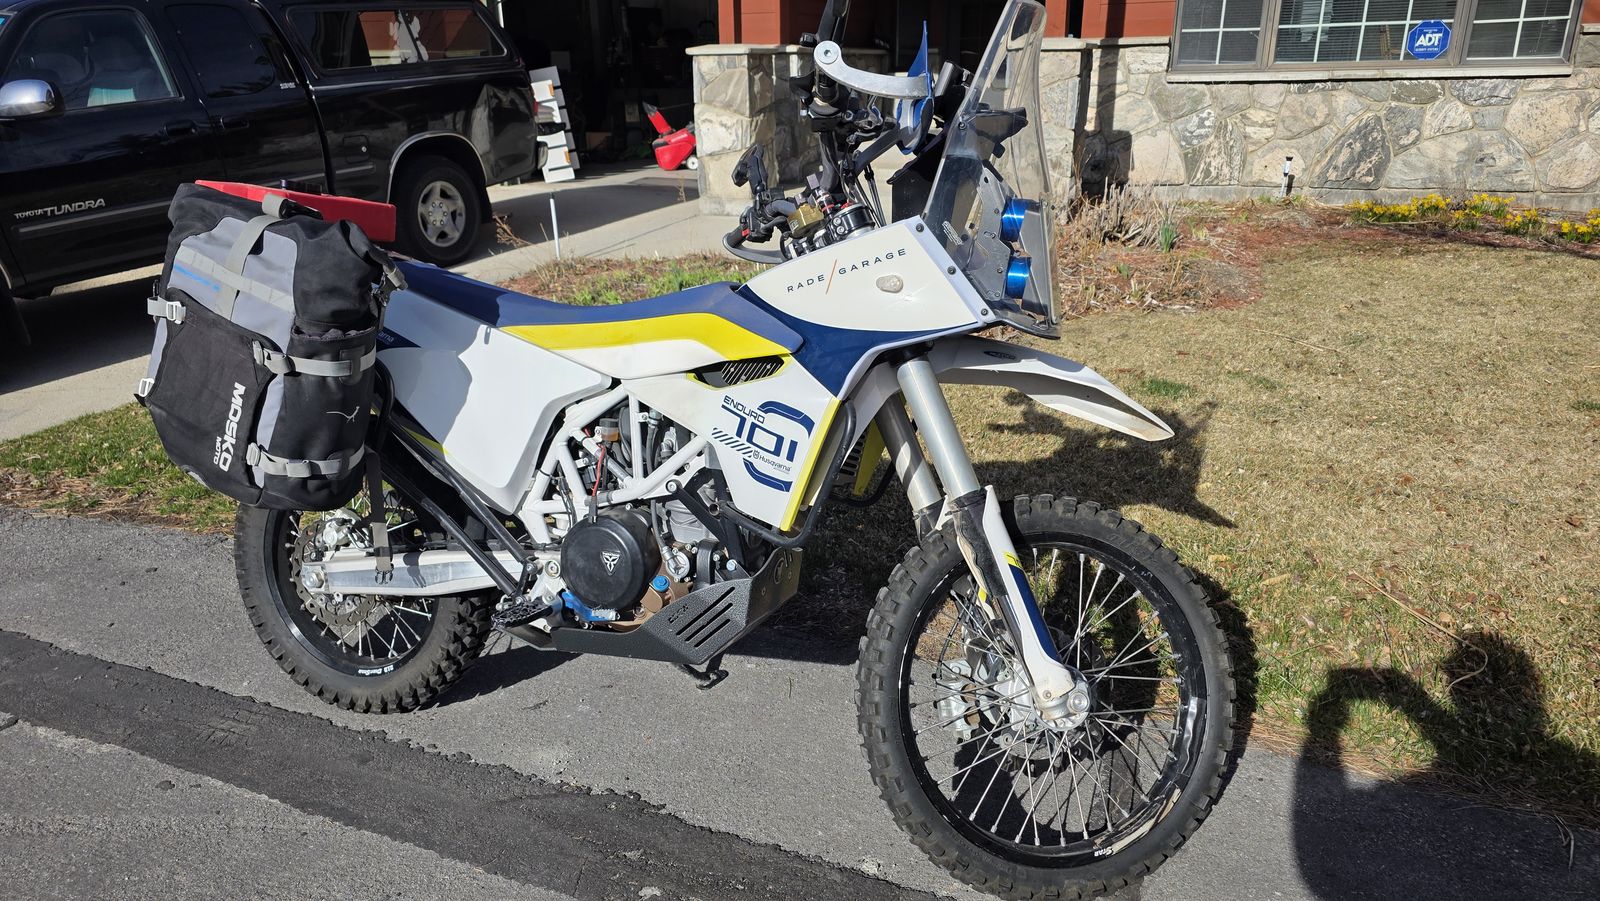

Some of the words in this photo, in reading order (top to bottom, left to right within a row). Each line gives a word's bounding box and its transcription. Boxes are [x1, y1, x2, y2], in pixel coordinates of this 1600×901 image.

[1415, 33, 1443, 47] ADT
[14, 209, 44, 219] TOYOTA
[43, 198, 106, 216] TUNDRA
[787, 274, 825, 293] RADE
[838, 248, 906, 275] GARAGE
[723, 395, 765, 424] ENDURO
[219, 382, 246, 472] MOSKO
[721, 404, 798, 463] 701
[213, 436, 222, 465] MOTO
[759, 454, 791, 472] Husqvarna
